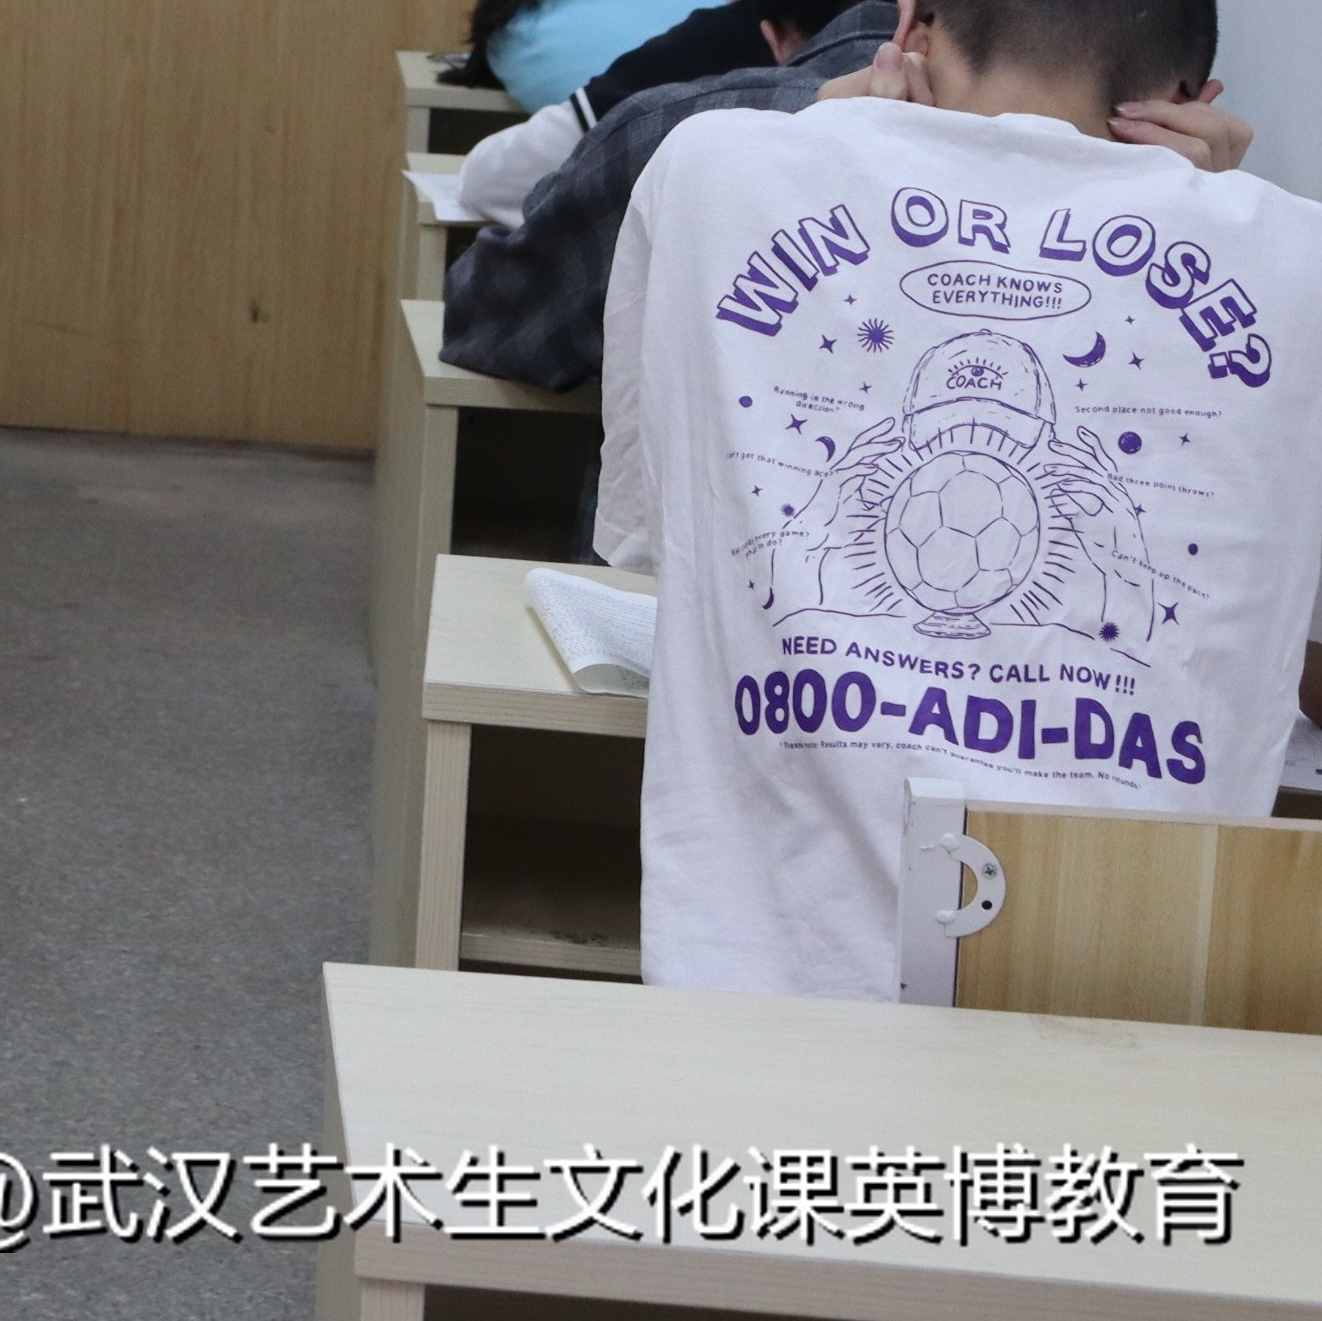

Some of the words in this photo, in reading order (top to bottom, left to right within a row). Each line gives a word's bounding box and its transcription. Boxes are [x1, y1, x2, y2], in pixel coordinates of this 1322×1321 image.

[716, 204, 870, 337] WIN
[891, 186, 1010, 253] OR
[1039, 208, 1272, 388] LOSE?
[927, 273, 991, 287] COACH
[996, 276, 1063, 294] KNOWS
[932, 289, 1062, 310] EVERYTHING!!!
[945, 374, 1002, 391] COACH
[773, 385, 808, 401] Running
[821, 396, 835, 405] the
[837, 399, 865, 411] wrong
[1074, 405, 1110, 414] Second
[1112, 405, 1138, 415] place
[1140, 406, 1156, 414] not
[1158, 407, 1182, 416] good
[1184, 409, 1223, 419] enough?
[757, 455, 776, 465] that
[781, 635, 838, 656] NEED
[845, 641, 982, 681] ANSWERS?
[988, 663, 1050, 683] CALL
[734, 668, 1207, 785] 0800-ADI-DAS
[850, 741, 869, 750] may
[895, 743, 922, 751] coach
[1024, 769, 1049, 779] make
[1052, 769, 1067, 779] the
